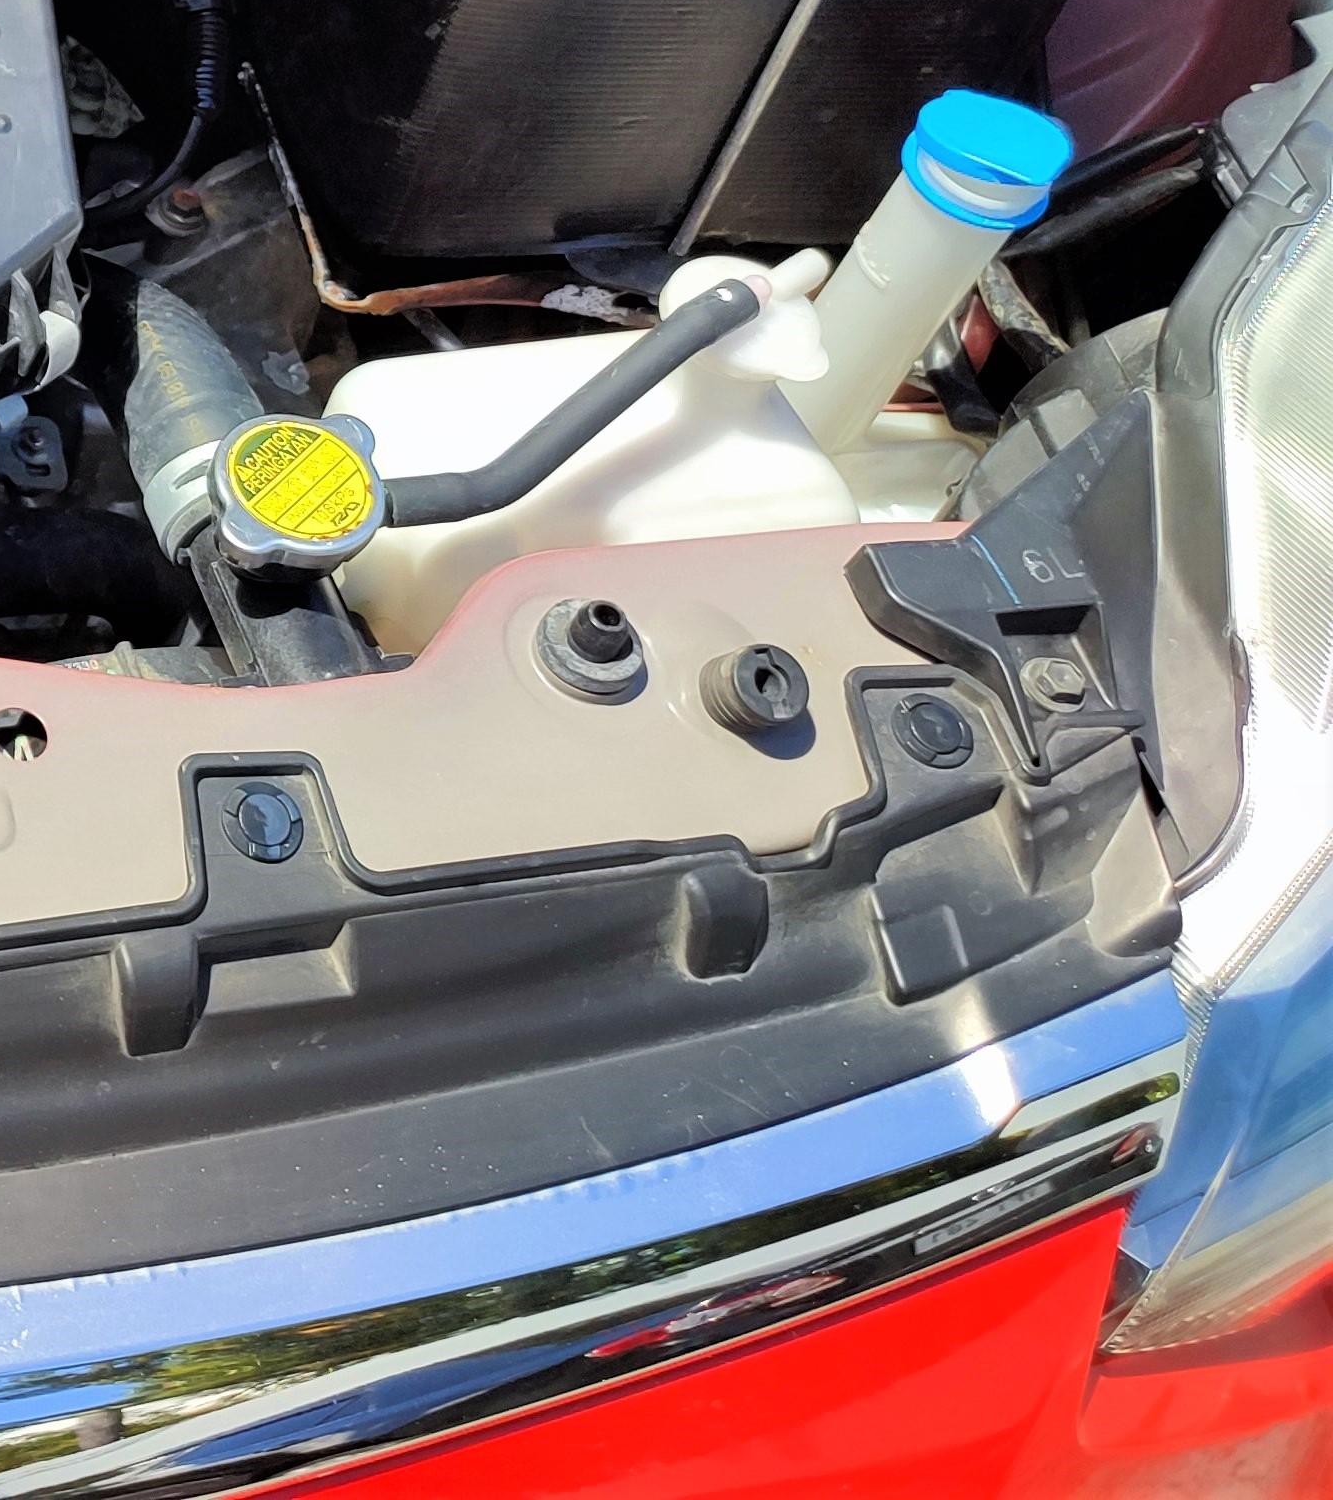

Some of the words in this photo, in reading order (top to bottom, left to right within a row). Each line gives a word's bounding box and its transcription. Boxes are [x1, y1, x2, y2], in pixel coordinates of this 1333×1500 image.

[244, 426, 296, 470] CAUTION
[244, 432, 313, 495] PERINGATAN
[1022, 548, 1087, 583] 6L
